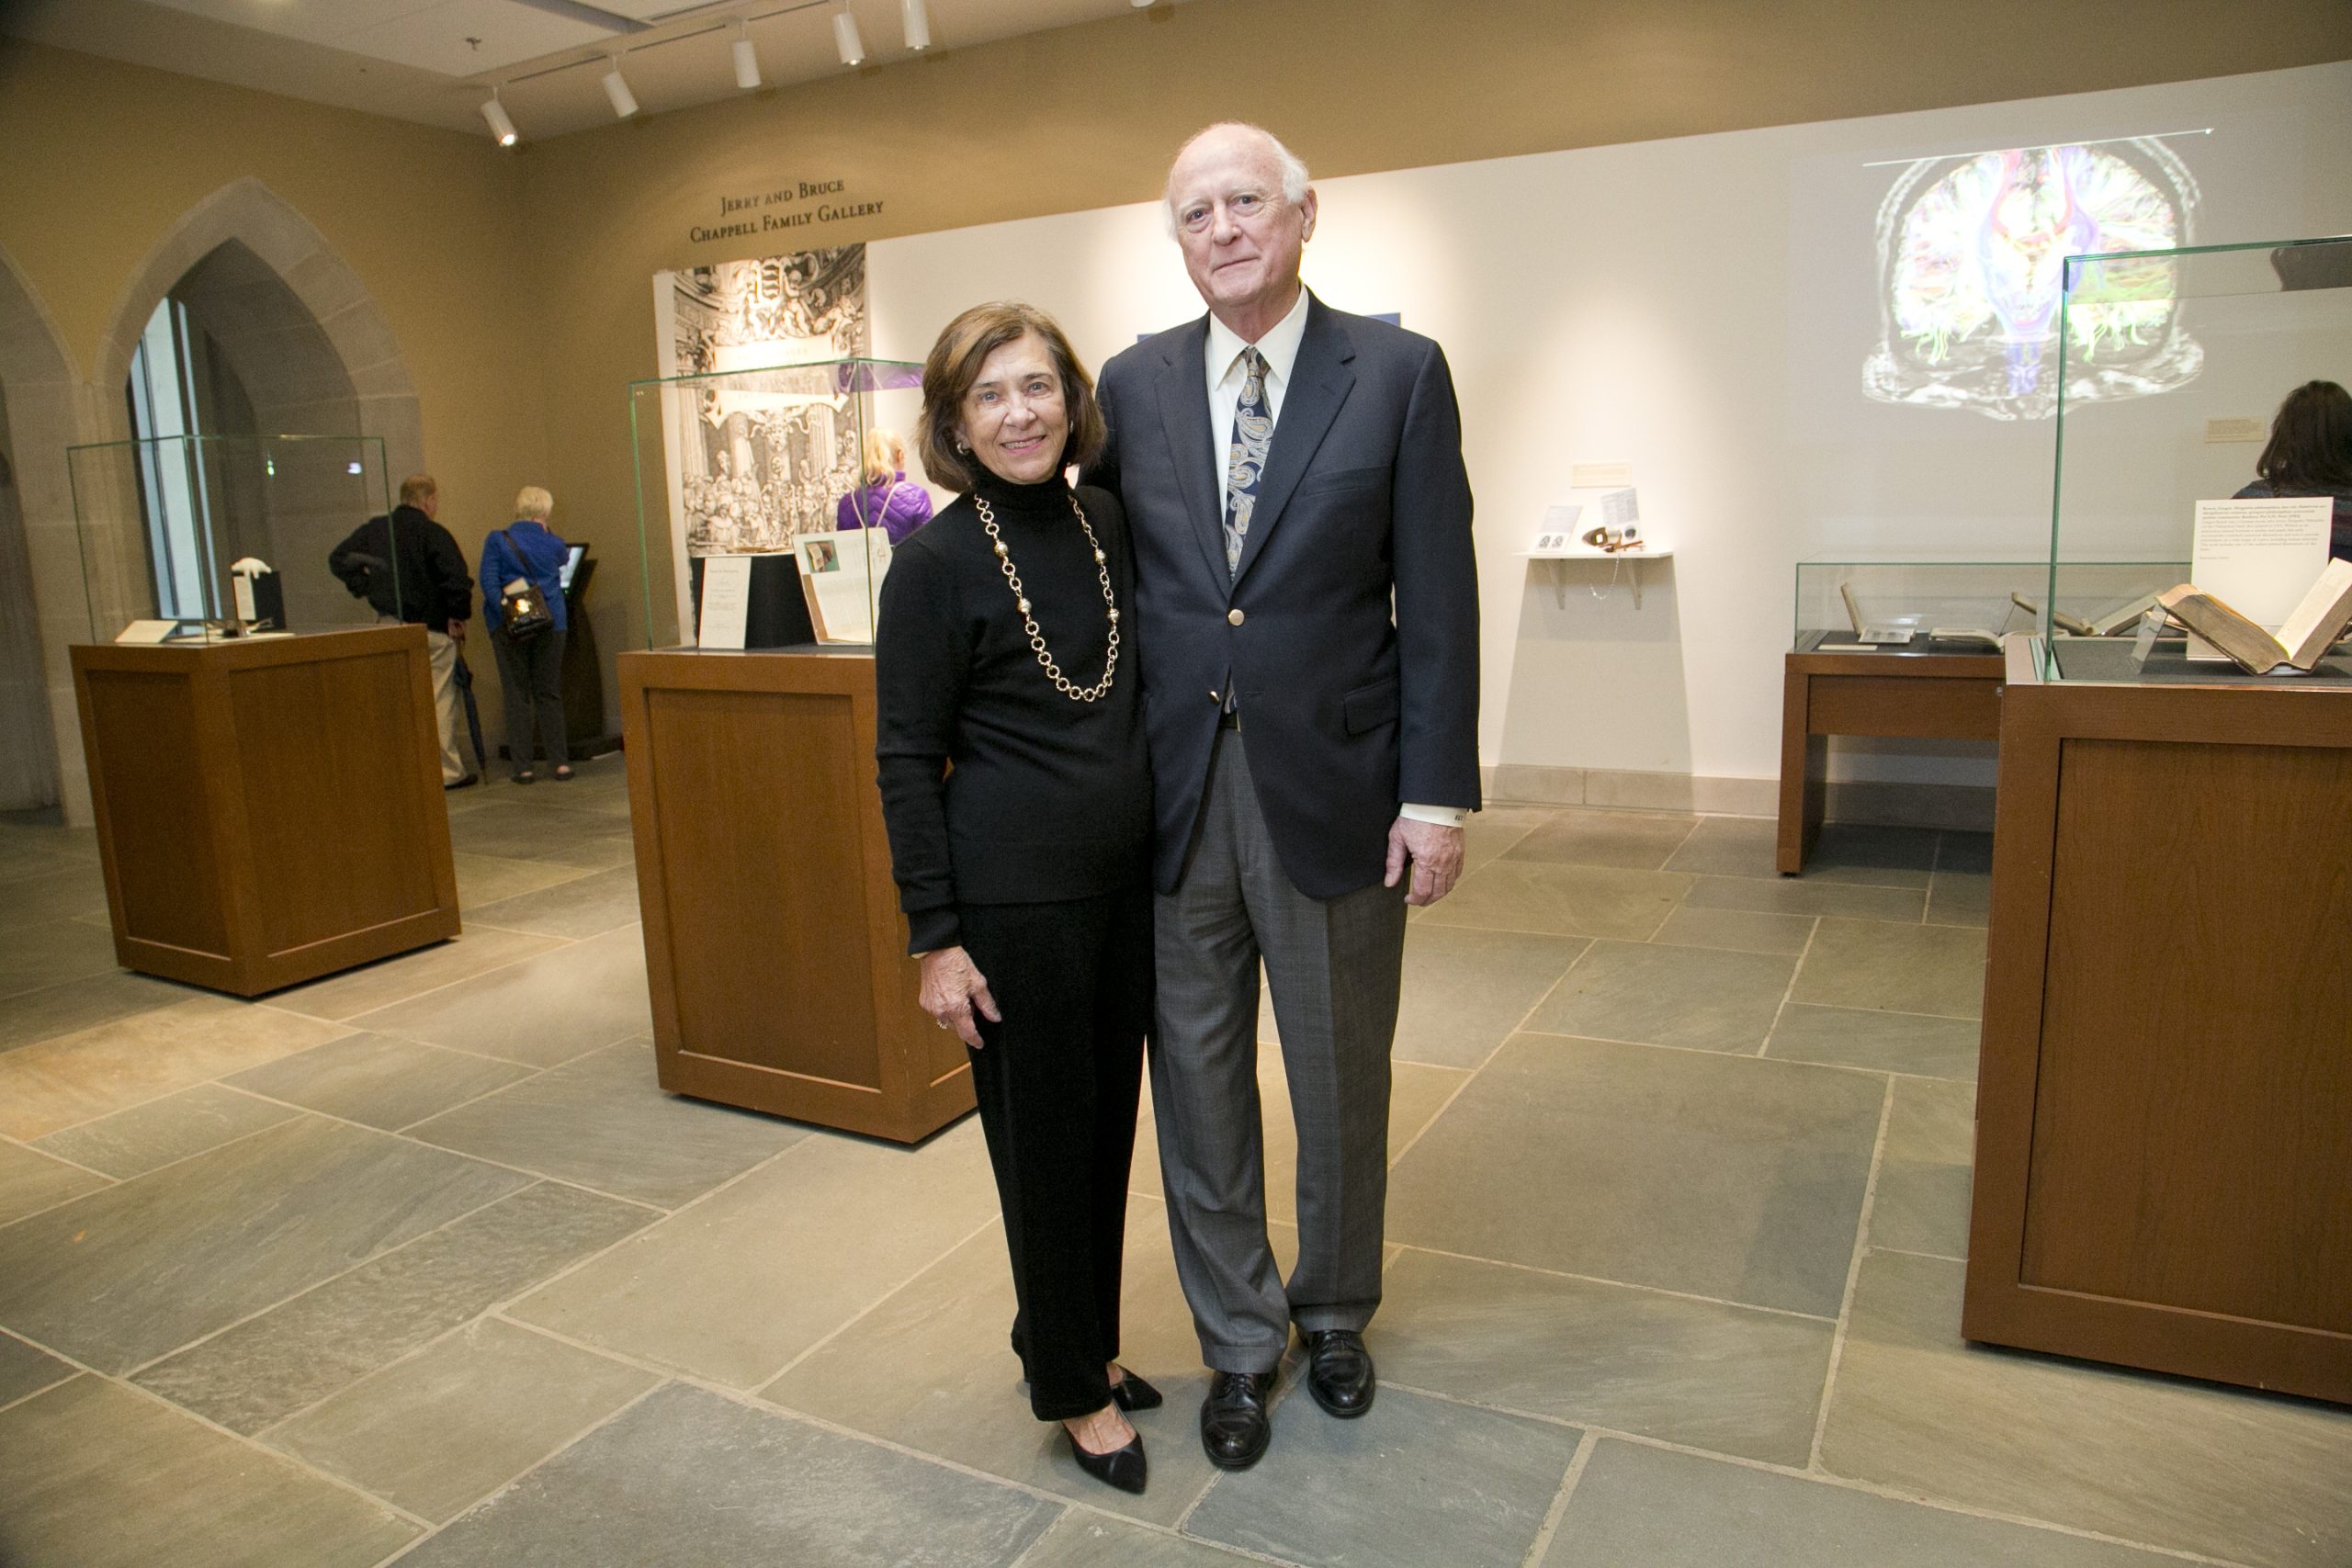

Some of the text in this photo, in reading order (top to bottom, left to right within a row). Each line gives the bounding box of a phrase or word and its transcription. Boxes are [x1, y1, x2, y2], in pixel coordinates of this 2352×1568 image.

[720, 180, 845, 217] JERRY AND BRUCE
[690, 201, 885, 243] CHAPPELL FAMILY GALLERY
